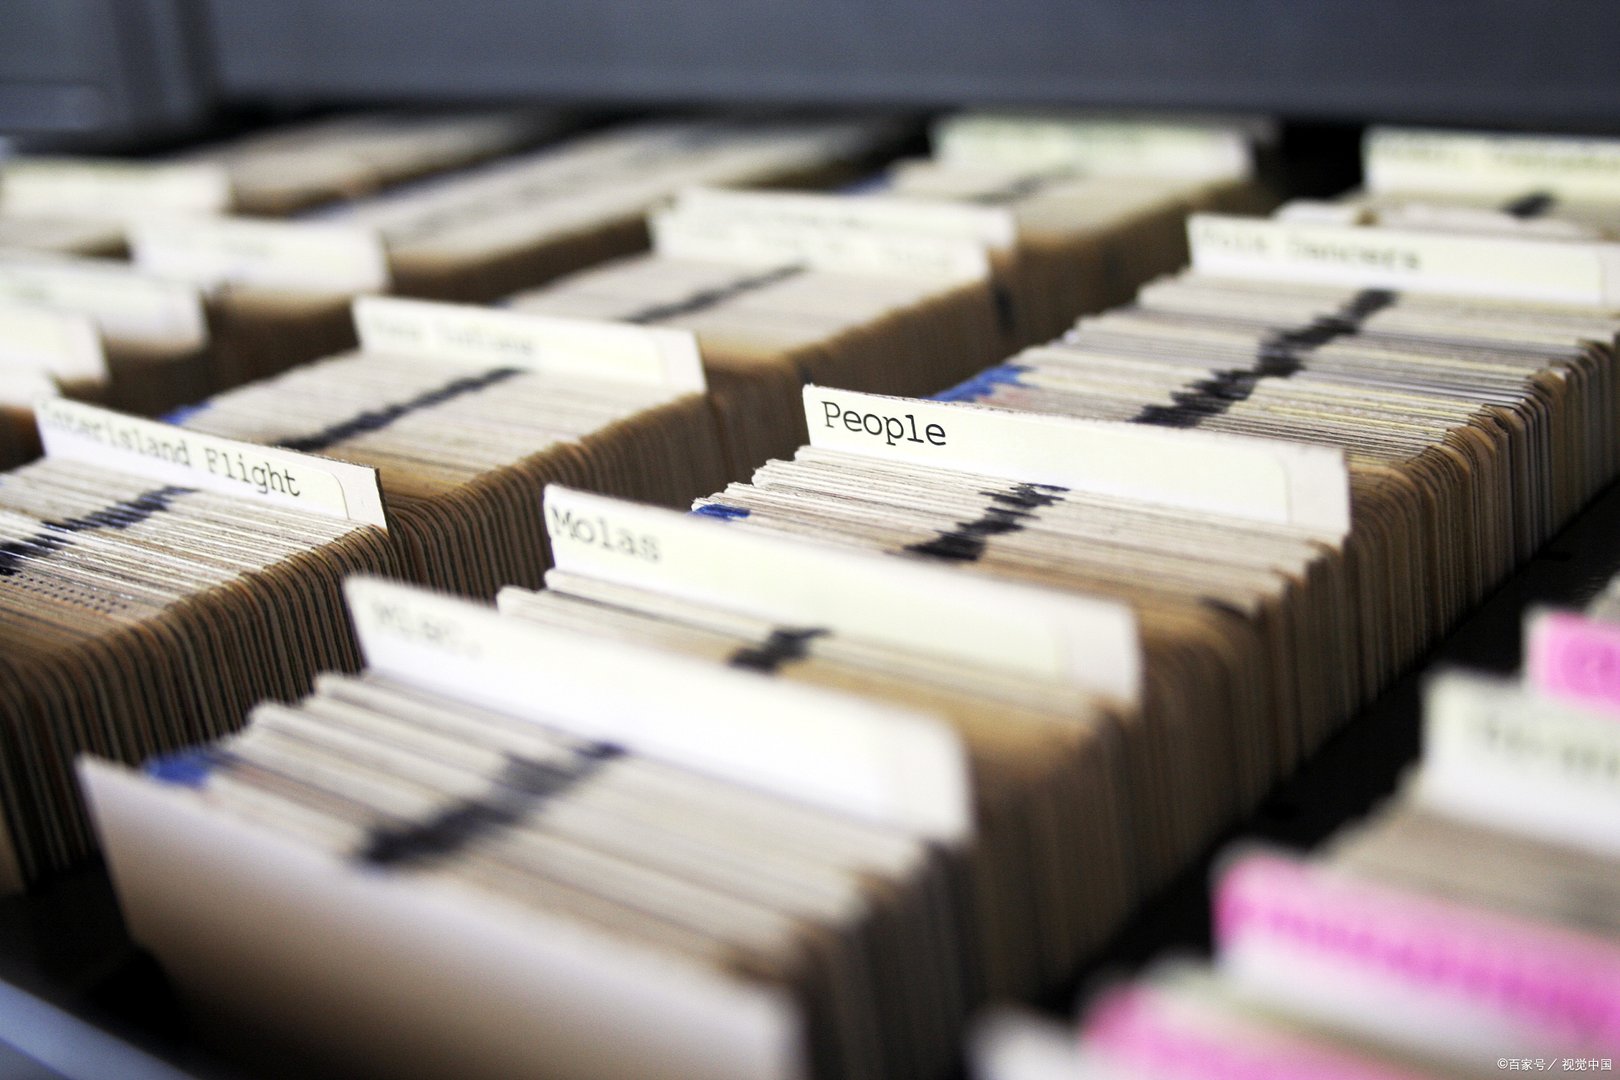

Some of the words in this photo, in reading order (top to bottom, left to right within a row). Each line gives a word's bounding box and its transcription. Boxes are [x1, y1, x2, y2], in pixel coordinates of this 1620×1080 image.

[821, 400, 947, 446] People
[204, 446, 301, 495] Flight
[550, 504, 662, 564] Molas
